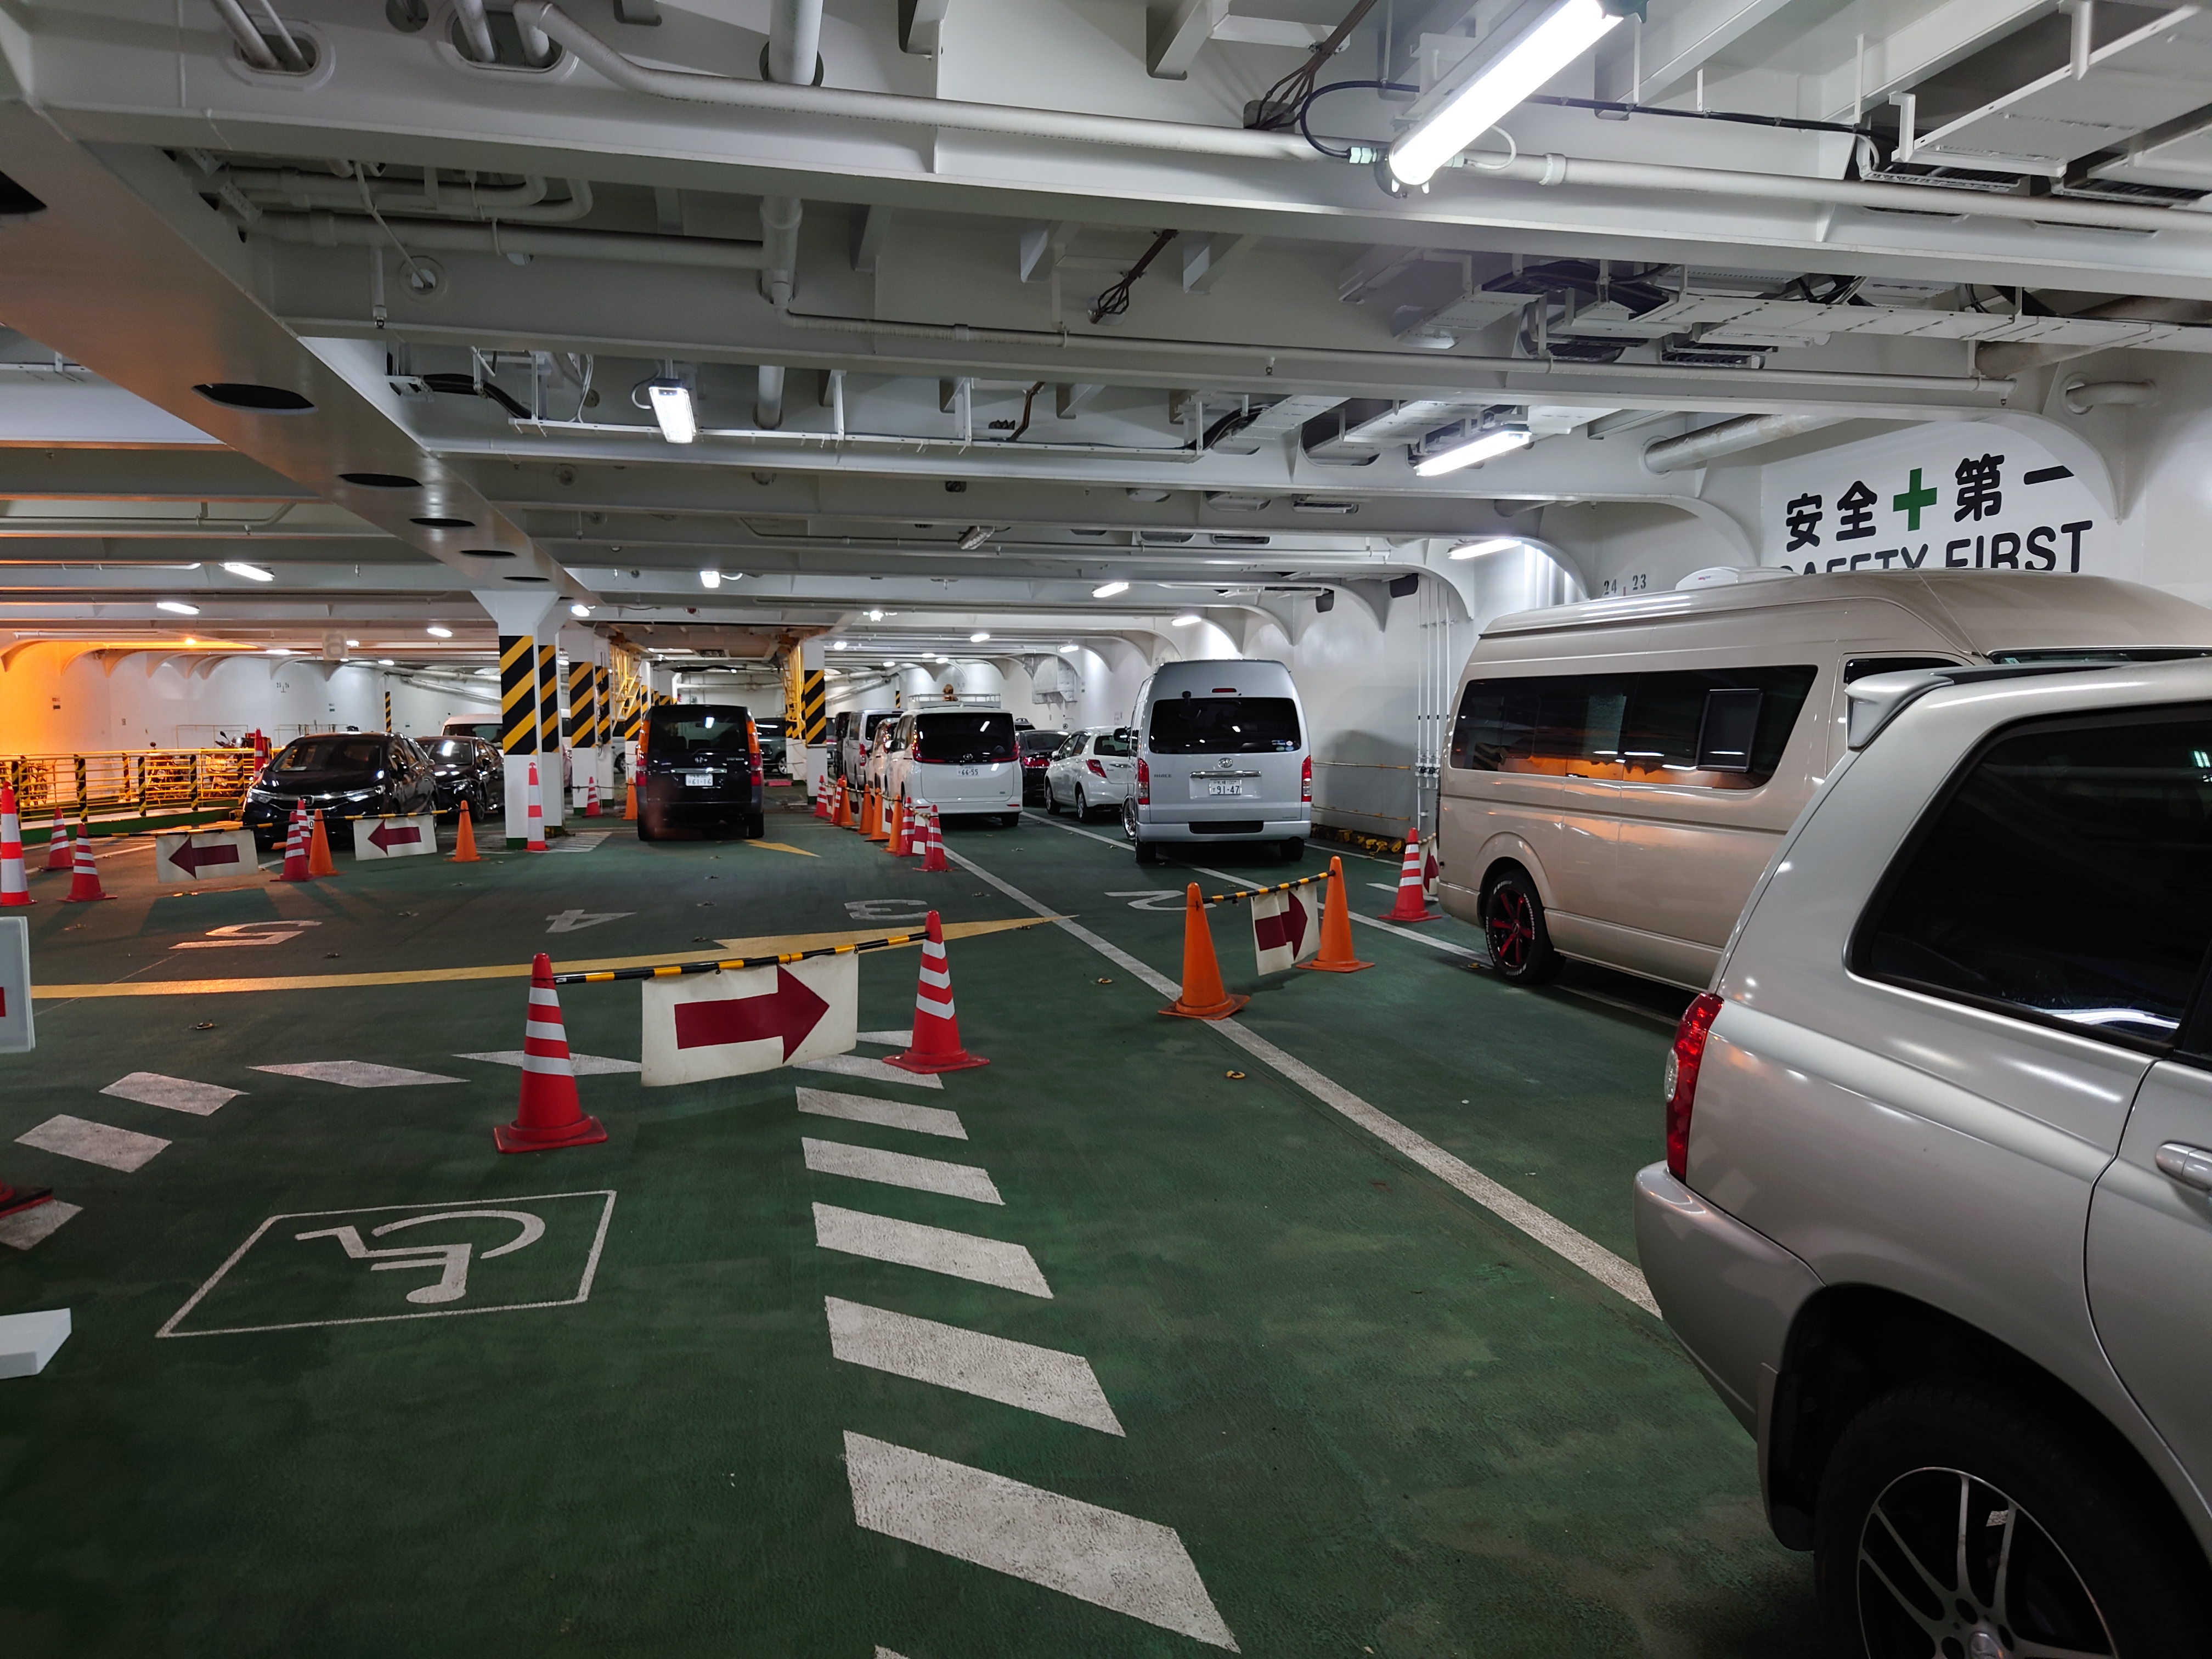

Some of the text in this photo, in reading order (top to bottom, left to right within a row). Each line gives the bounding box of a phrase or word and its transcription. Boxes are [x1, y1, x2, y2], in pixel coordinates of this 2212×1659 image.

[1786, 453, 2075, 552] 安全 第一
[1945, 520, 2093, 573] FIRST
[1604, 574, 1646, 595] 24 23
[1217, 786, 1240, 794] 91-47
[546, 909, 637, 933] 4
[168, 920, 323, 949] 5
